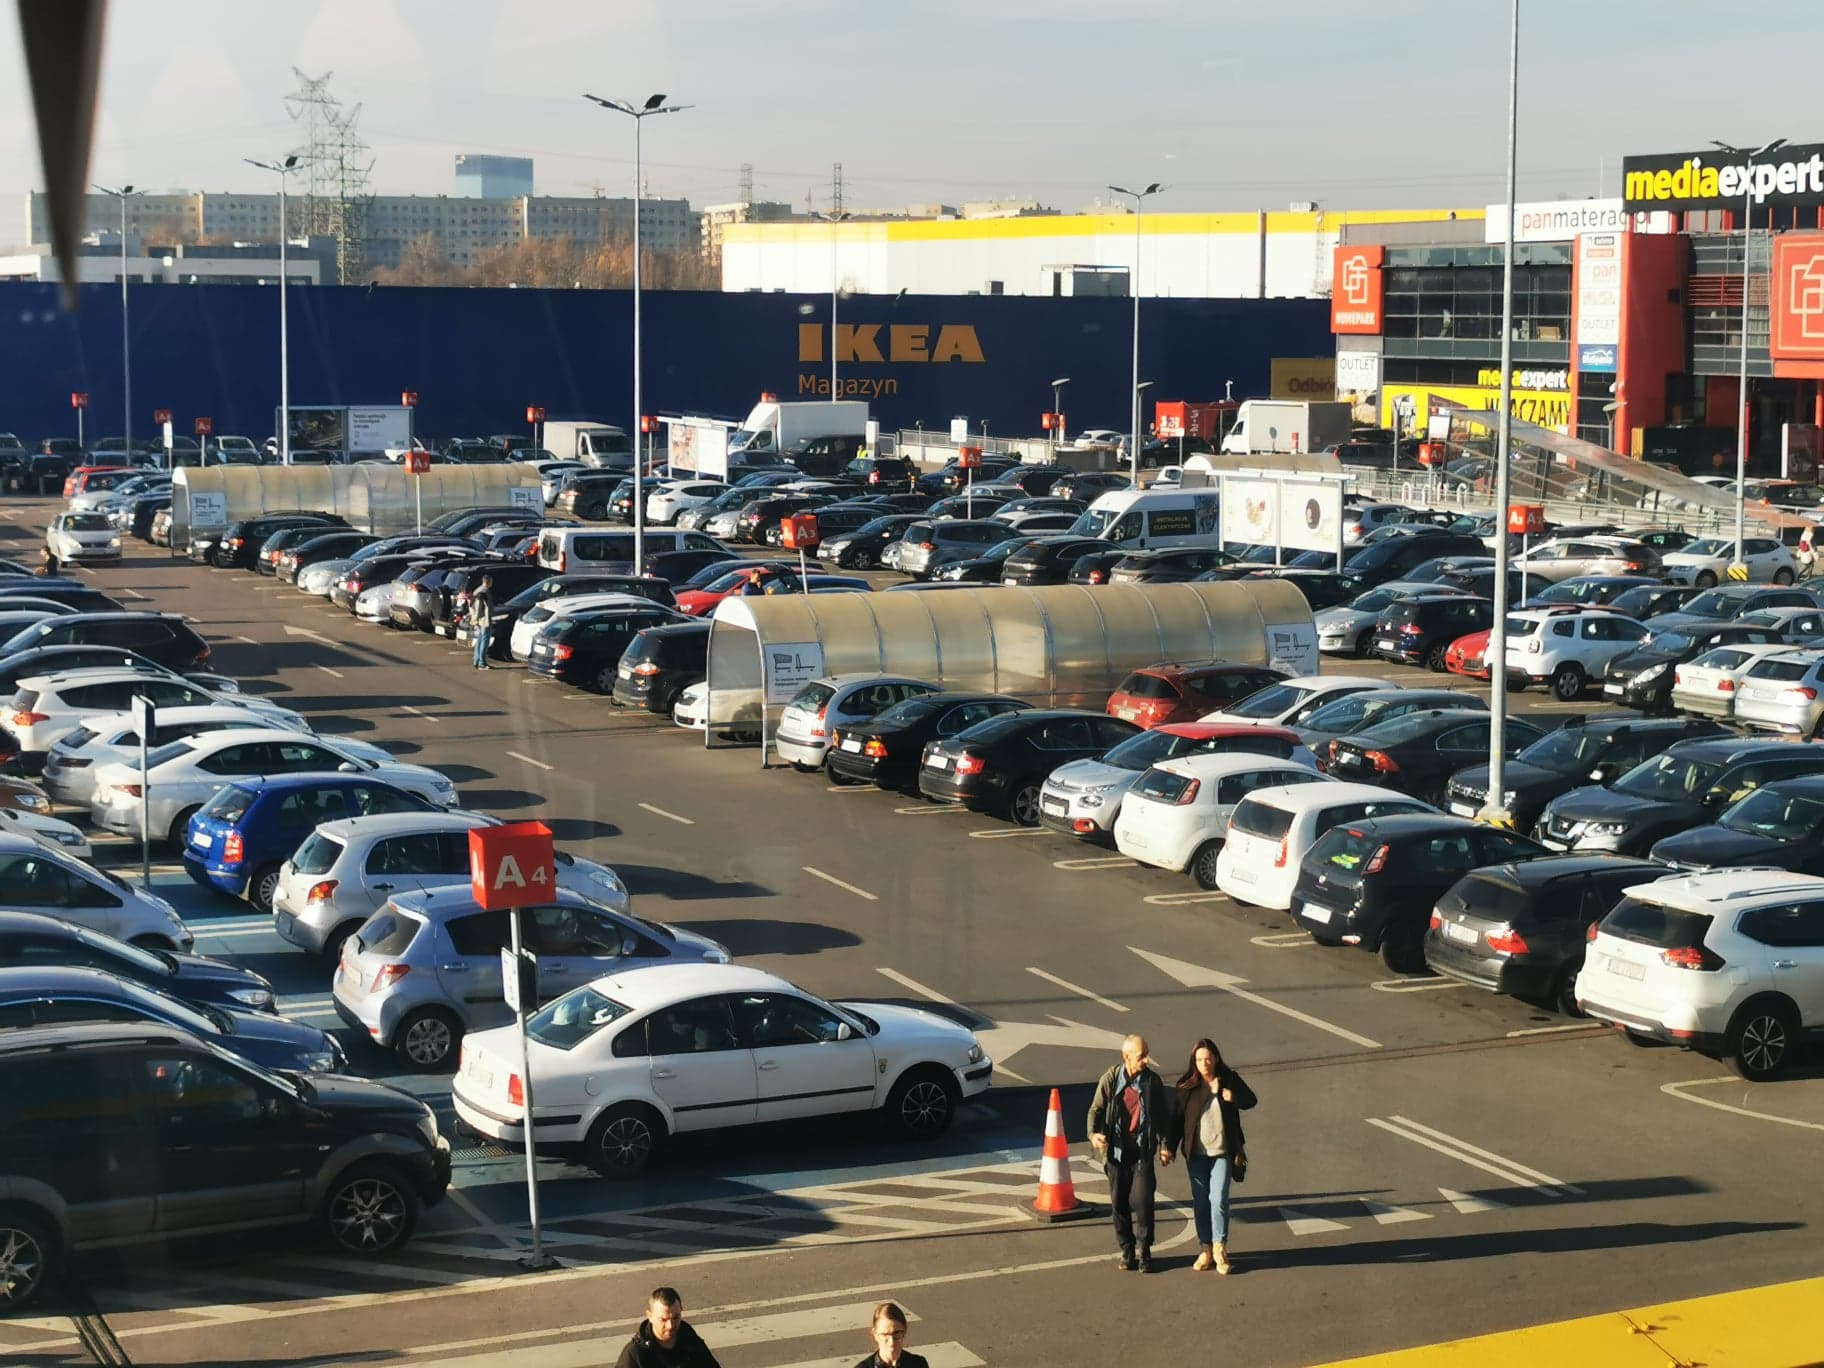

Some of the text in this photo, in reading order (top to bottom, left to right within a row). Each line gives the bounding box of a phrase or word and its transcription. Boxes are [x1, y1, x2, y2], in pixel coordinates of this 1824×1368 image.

[1626, 153, 1824, 204] mediaexpert
[1522, 207, 1651, 237] panmateracpl
[798, 323, 985, 363] IKEA
[1340, 358, 1375, 370] OUTLET
[798, 374, 898, 399] Magazyn
[1478, 369, 1567, 391] meaexpert
[797, 526, 817, 540] A3
[494, 854, 548, 890] A4
